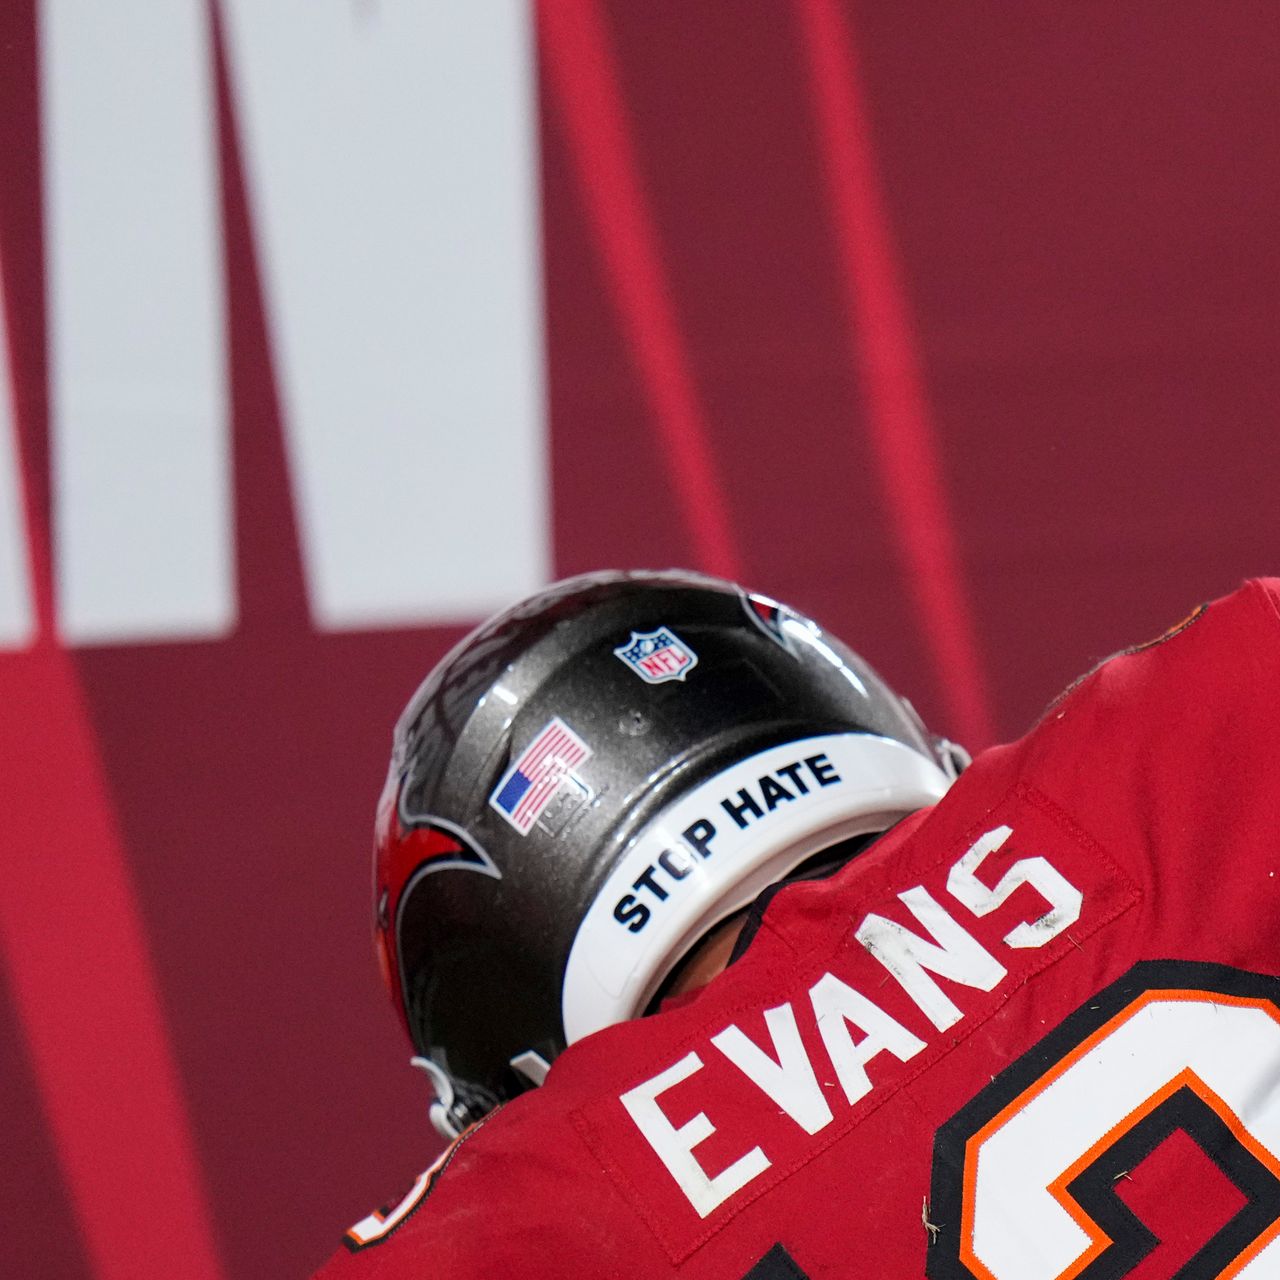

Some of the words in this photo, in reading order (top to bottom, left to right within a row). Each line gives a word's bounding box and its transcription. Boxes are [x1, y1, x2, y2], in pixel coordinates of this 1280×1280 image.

[639, 647, 690, 677] NFL
[613, 818, 717, 934] STOP
[720, 753, 842, 830] HATE
[619, 824, 1084, 1219] EVANS
